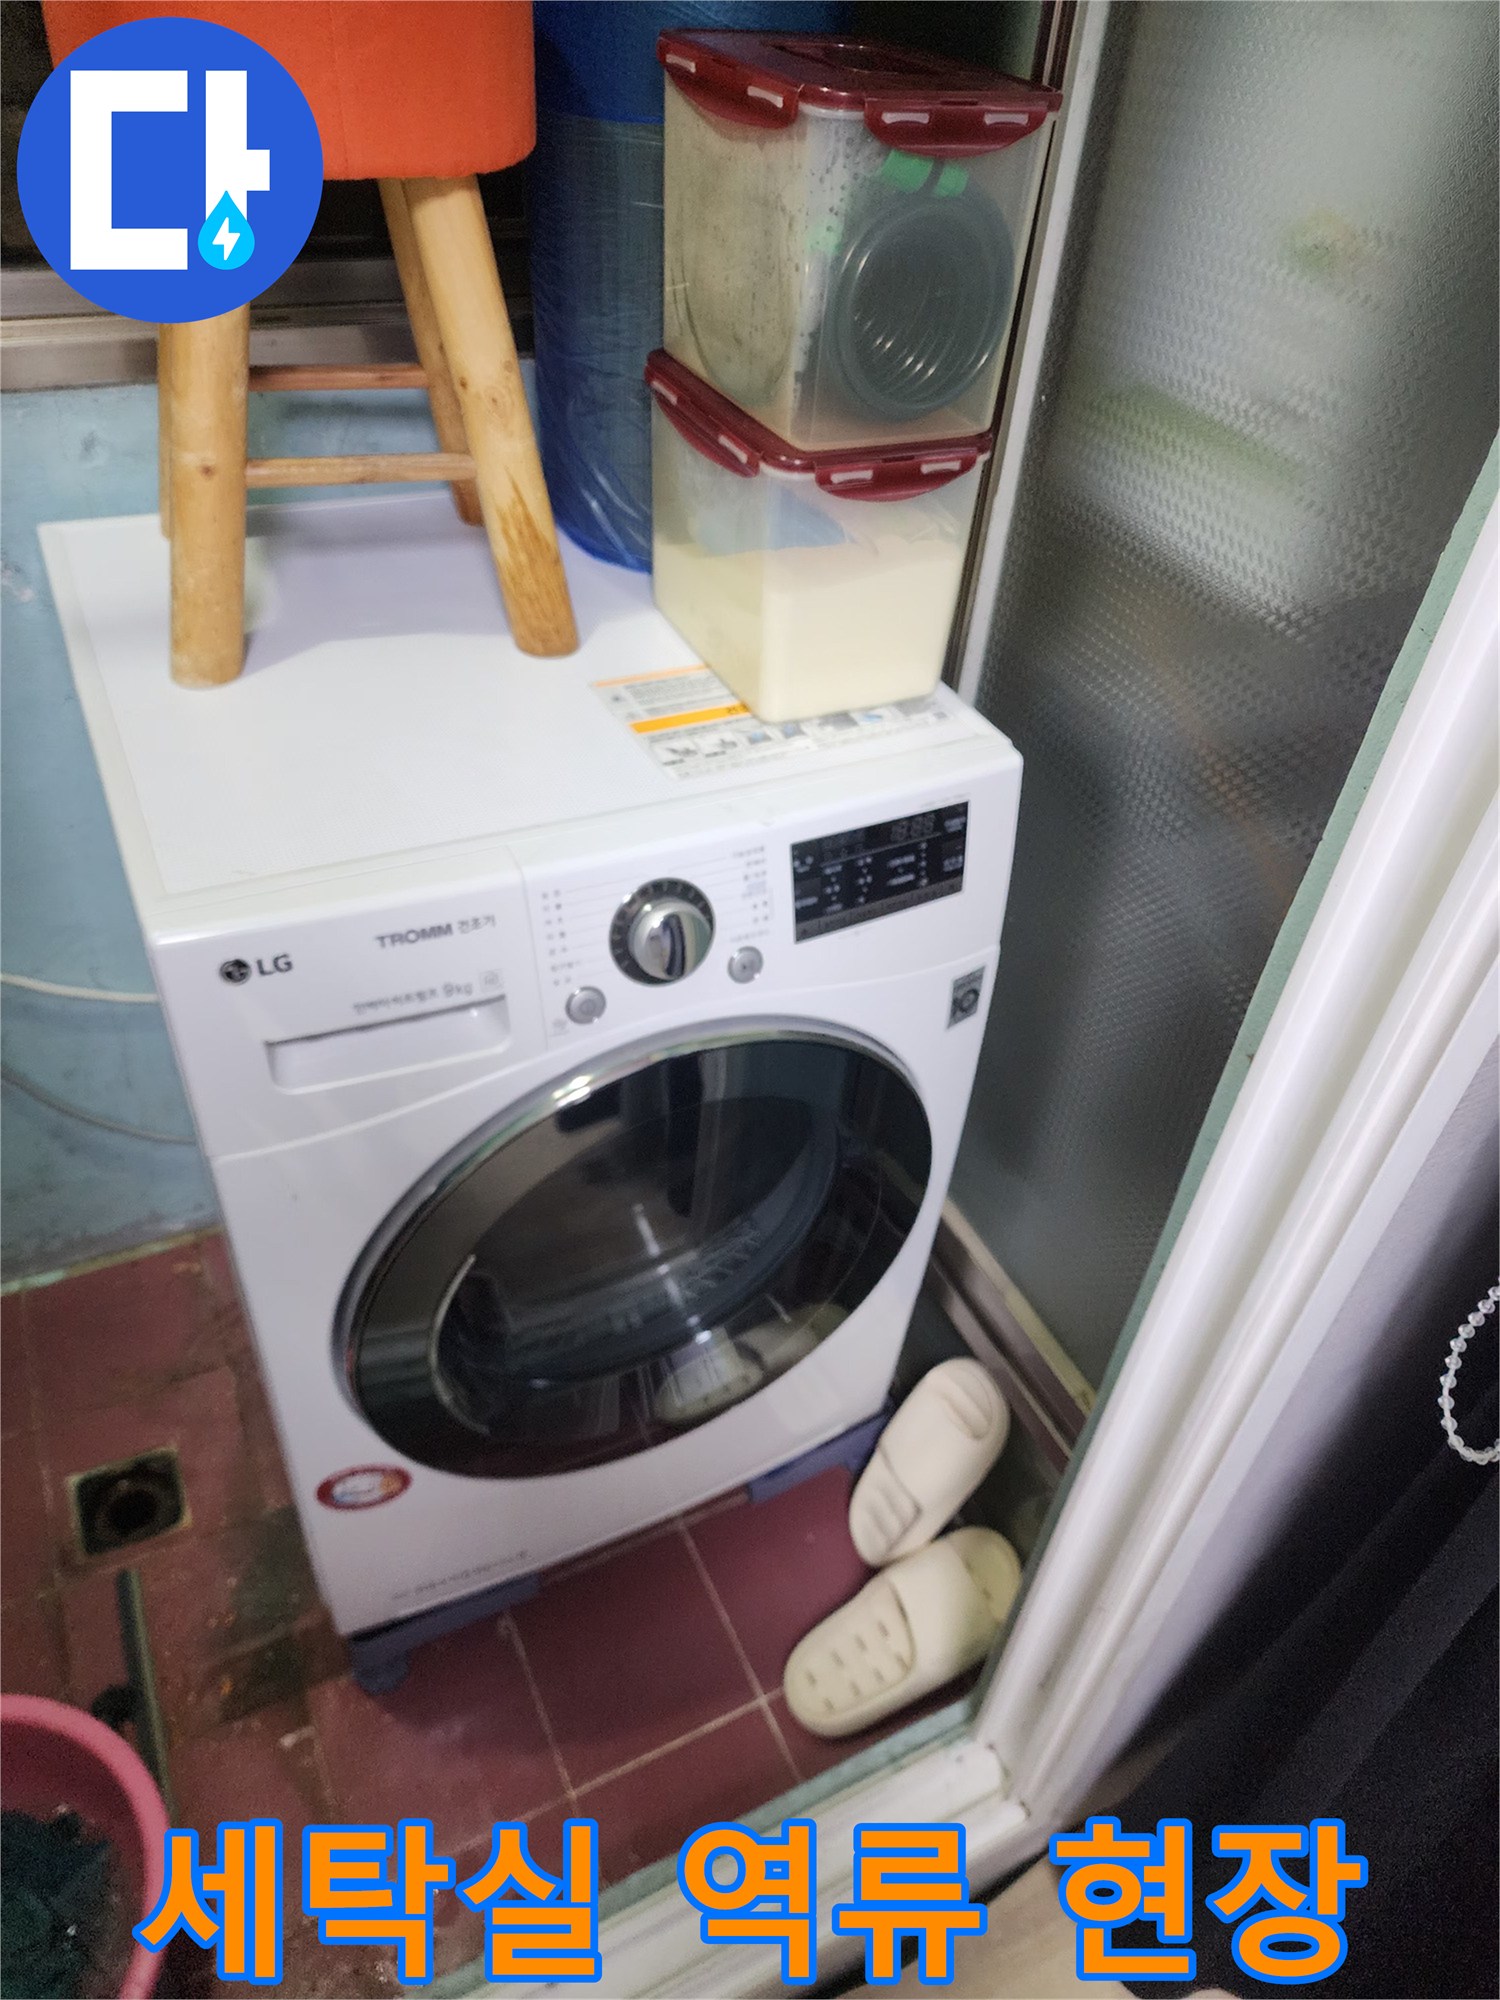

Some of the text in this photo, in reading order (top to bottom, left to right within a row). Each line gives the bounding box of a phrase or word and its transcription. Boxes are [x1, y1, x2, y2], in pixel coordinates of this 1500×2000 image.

[375, 914, 497, 949] TROMM 건조기
[256, 953, 294, 977] LG
